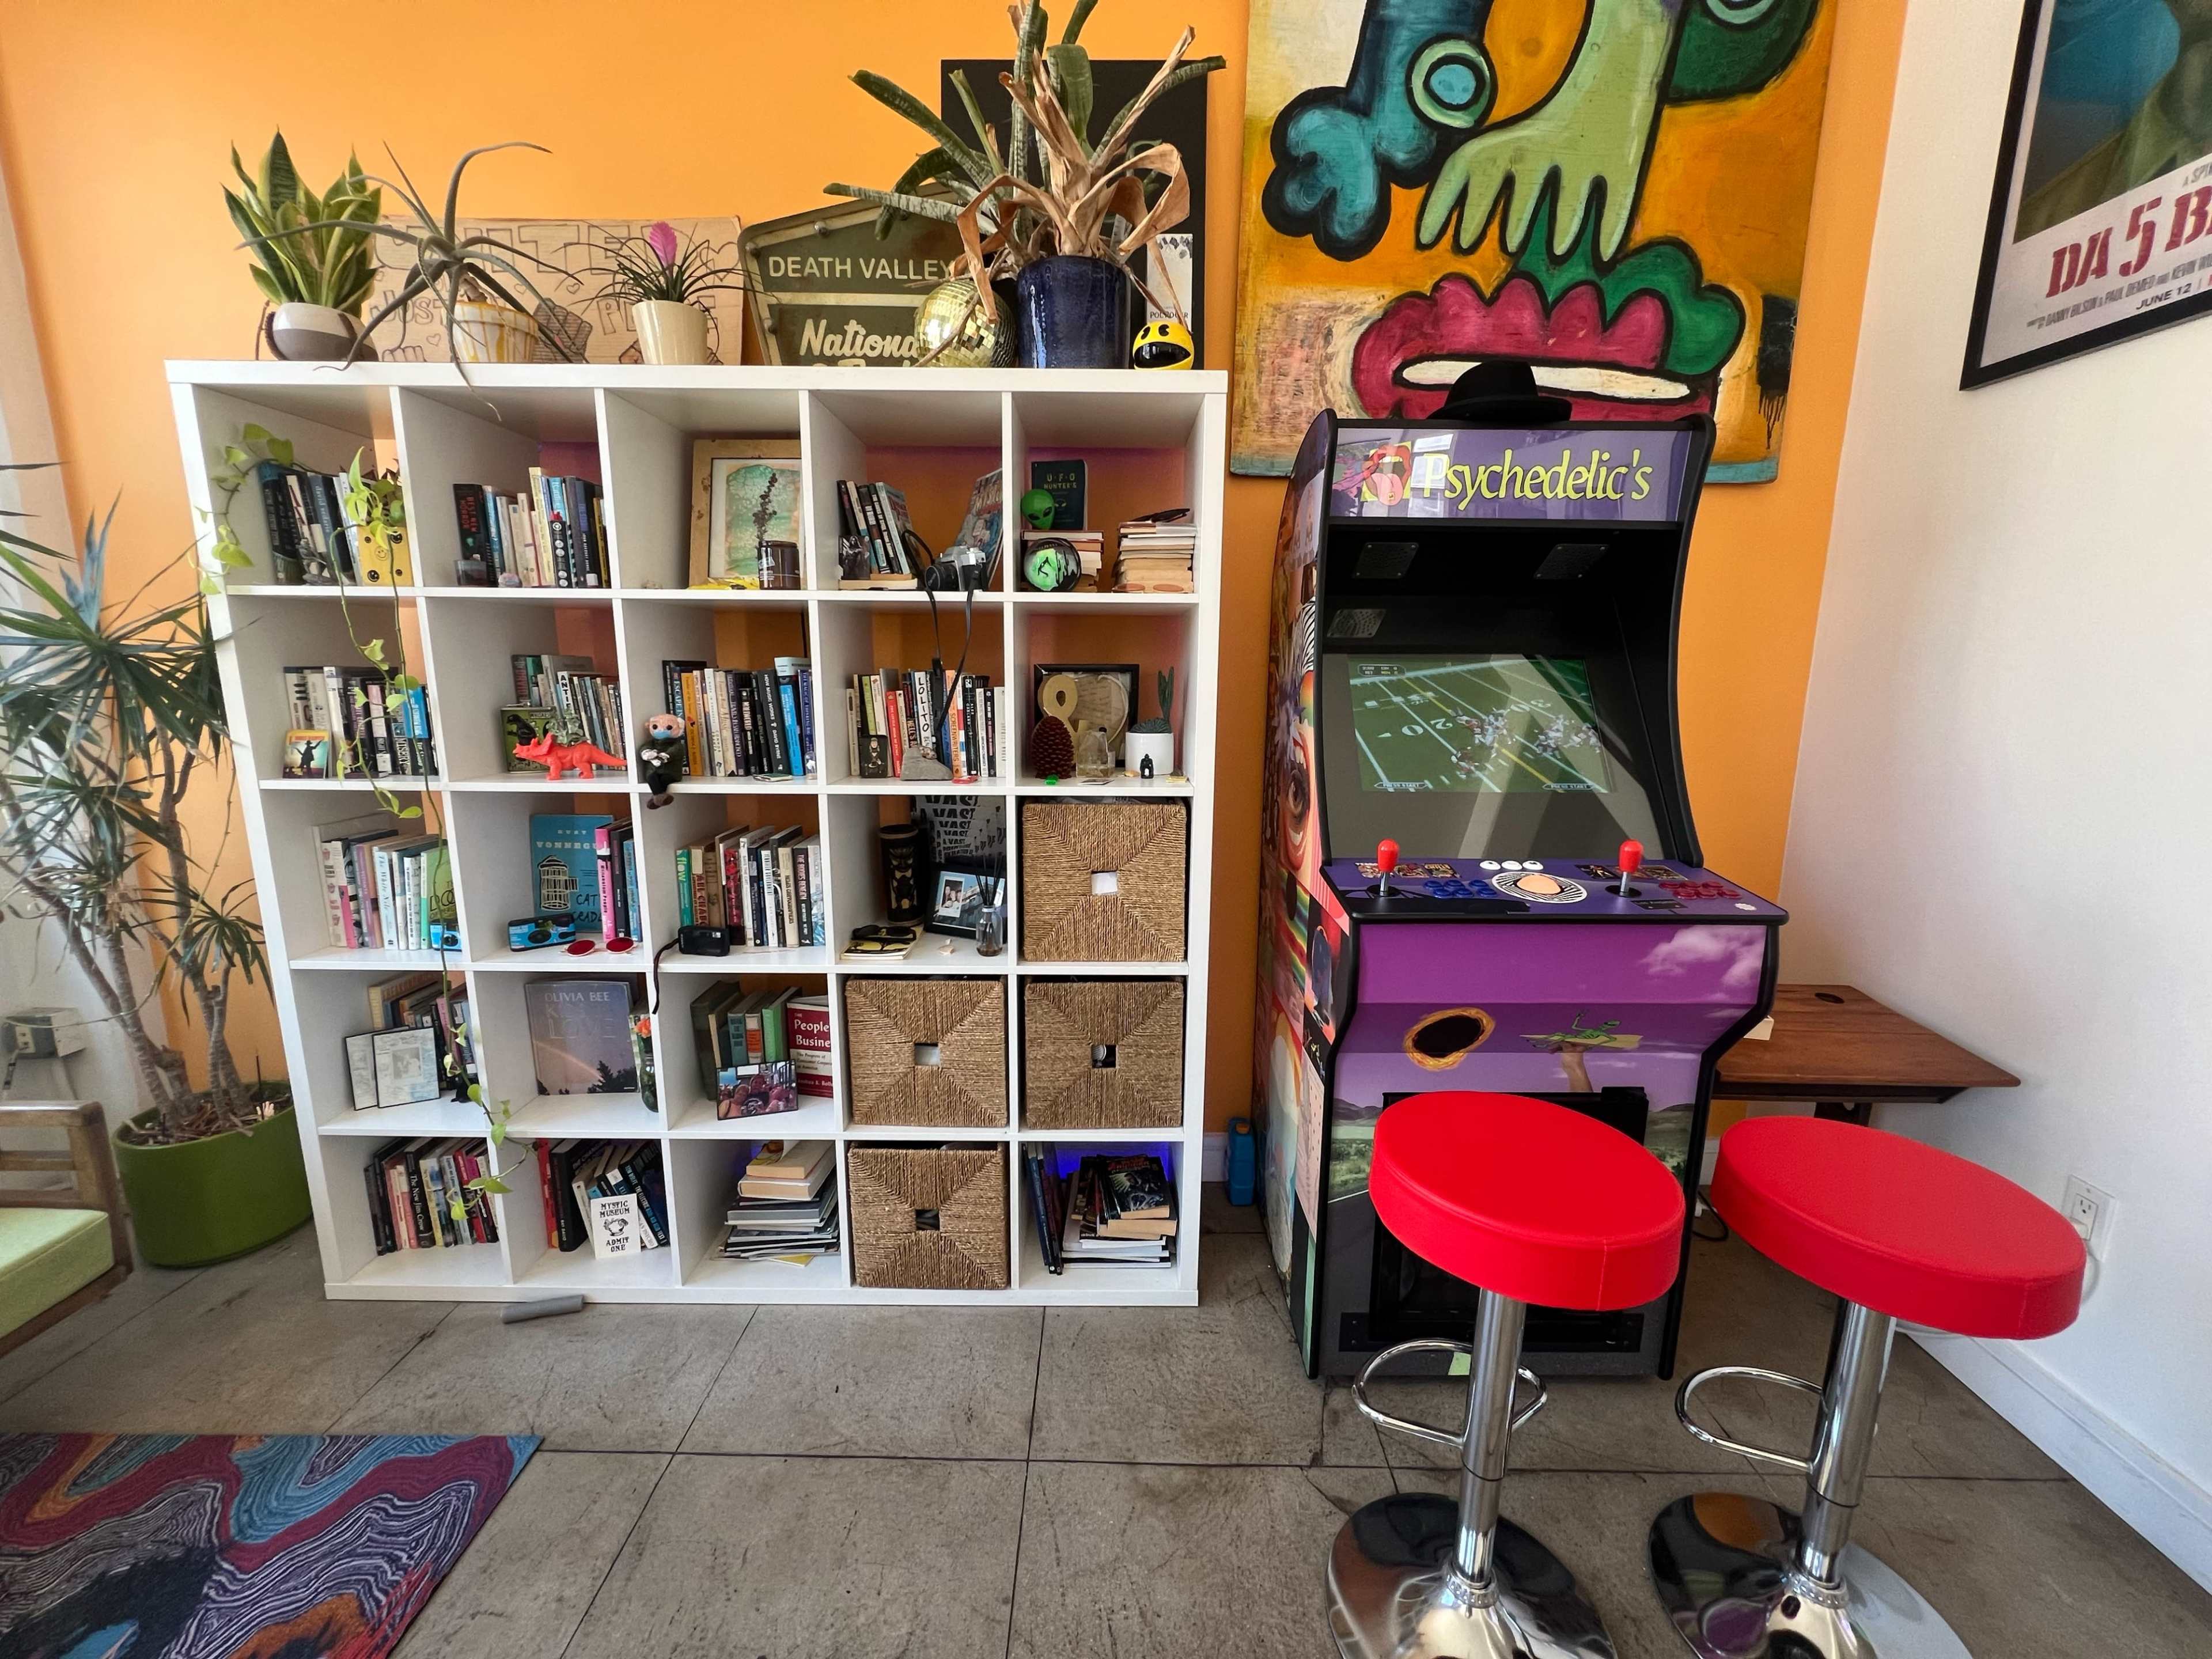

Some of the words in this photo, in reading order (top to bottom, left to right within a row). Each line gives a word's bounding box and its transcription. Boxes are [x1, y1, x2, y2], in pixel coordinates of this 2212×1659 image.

[2046, 227, 2113, 298] DA
[2119, 197, 2162, 277] 5
[2165, 185, 2212, 252] B
[768, 257, 852, 279] DEATH
[859, 258, 953, 281] VALLEY
[2136, 289, 2173, 310] JUNE
[2177, 283, 2192, 296] 12
[800, 319, 920, 358] Nationa
[1423, 448, 1653, 511] Psychedelic's
[673, 680, 683, 708] ESCAPE
[917, 677, 930, 732] LOLITO
[907, 719, 917, 740] HELL'S
[950, 713, 960, 762] SCREENWRITERS
[396, 738, 411, 767] MISERY
[535, 841, 597, 850] VONNEGU
[797, 854, 805, 863] THE
[676, 857, 686, 882] flow
[797, 863, 806, 880] BODIES
[798, 880, 807, 900] BENEATH
[545, 992, 584, 1002] OLIVIA
[589, 991, 611, 1002] BEE
[794, 1019, 830, 1034] People
[796, 1035, 831, 1048] Busine
[410, 1175, 418, 1186] The
[411, 1187, 421, 1200] New
[635, 1185, 643, 1194] THE
[415, 1201, 423, 1214] Jim
[600, 1207, 630, 1218] MUSEUM
[601, 1200, 629, 1210] MYSTIC
[416, 1214, 425, 1232] Crow
[605, 1236, 630, 1247] ADMIT
[611, 1244, 626, 1252] ONE
